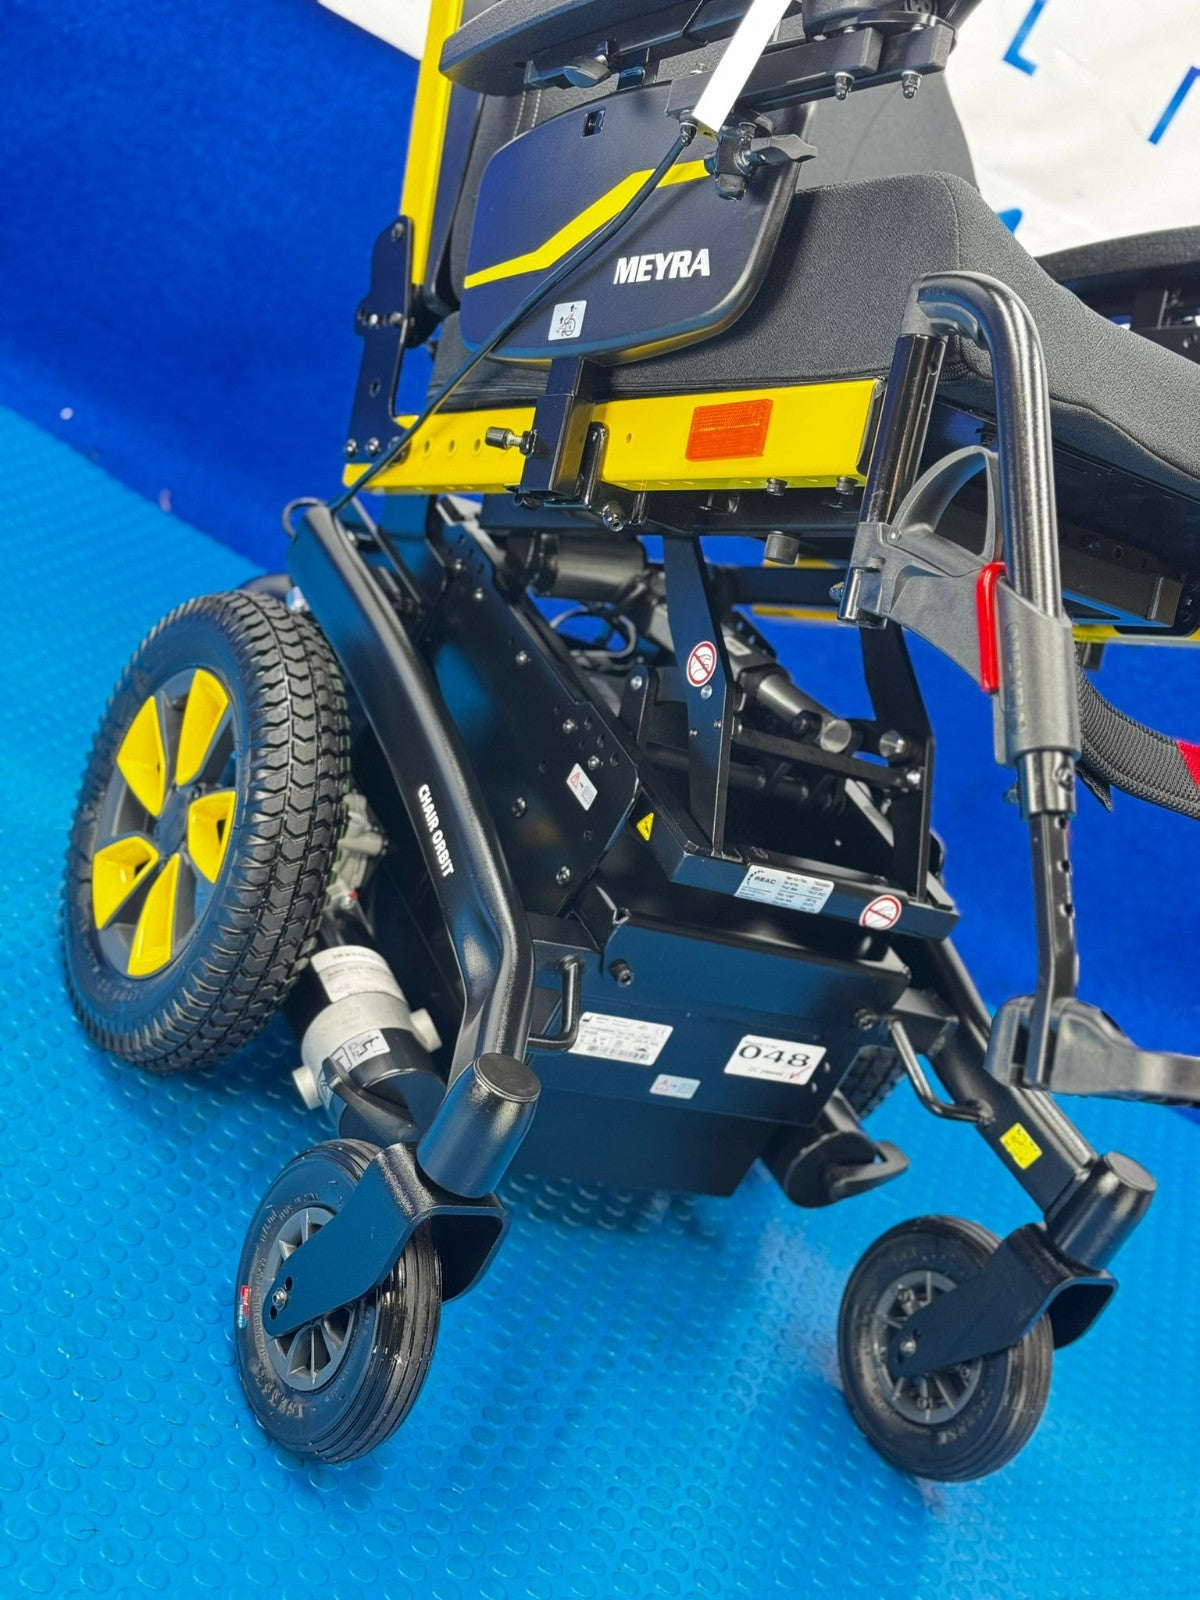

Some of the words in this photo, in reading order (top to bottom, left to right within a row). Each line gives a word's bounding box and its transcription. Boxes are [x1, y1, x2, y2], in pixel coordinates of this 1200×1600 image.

[613, 249, 710, 284] MEYRA
[418, 784, 439, 832] CHAIR
[432, 829, 455, 877] ORBIT
[739, 1045, 810, 1066] 048
